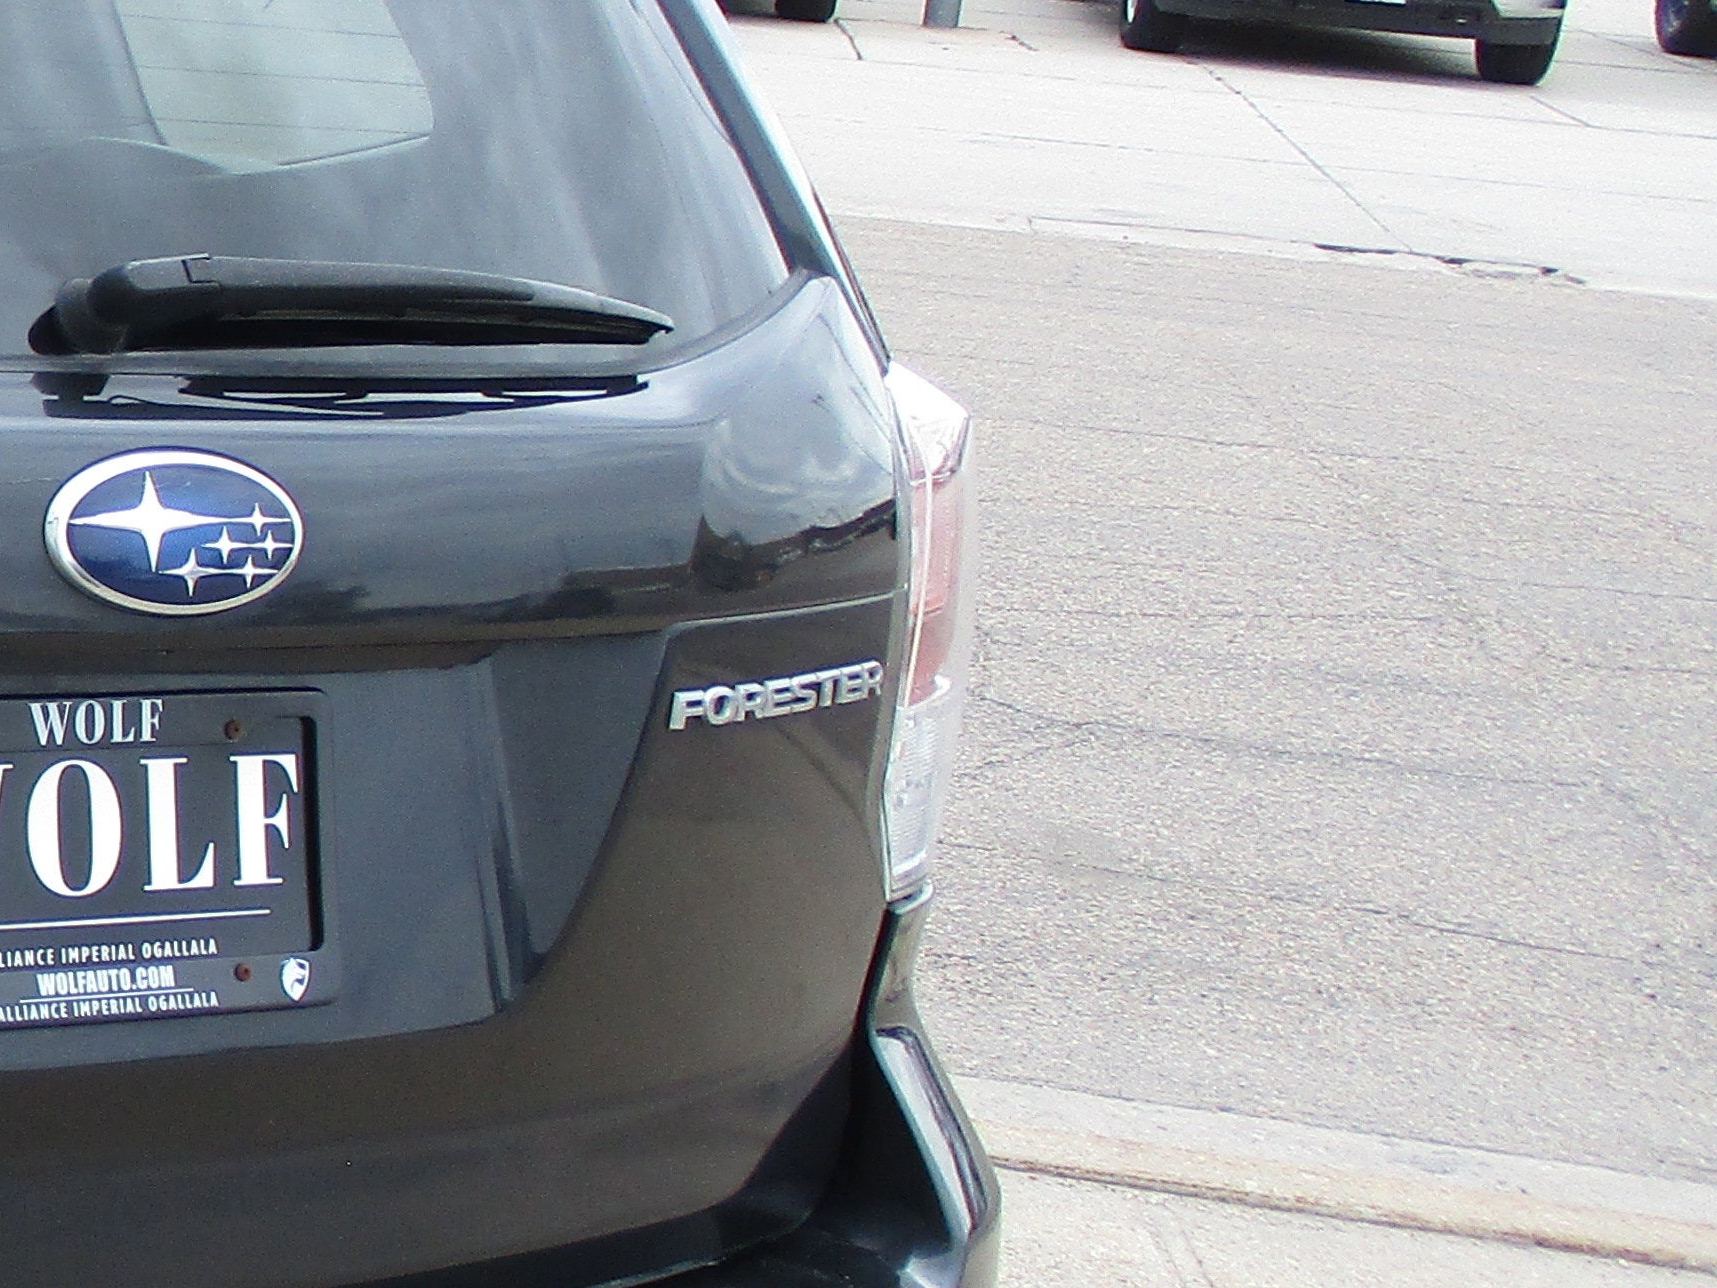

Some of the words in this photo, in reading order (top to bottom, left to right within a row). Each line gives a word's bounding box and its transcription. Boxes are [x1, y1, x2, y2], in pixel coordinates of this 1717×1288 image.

[668, 660, 884, 731] FORESTER
[28, 698, 164, 747] WOLF
[61, 943, 136, 964] IMPERIAL
[141, 938, 219, 959] OGALLALA
[36, 965, 176, 997] WOLFAUTO.COM
[73, 997, 143, 1018] IMPERIAL
[147, 991, 220, 1012] OGALLALA
